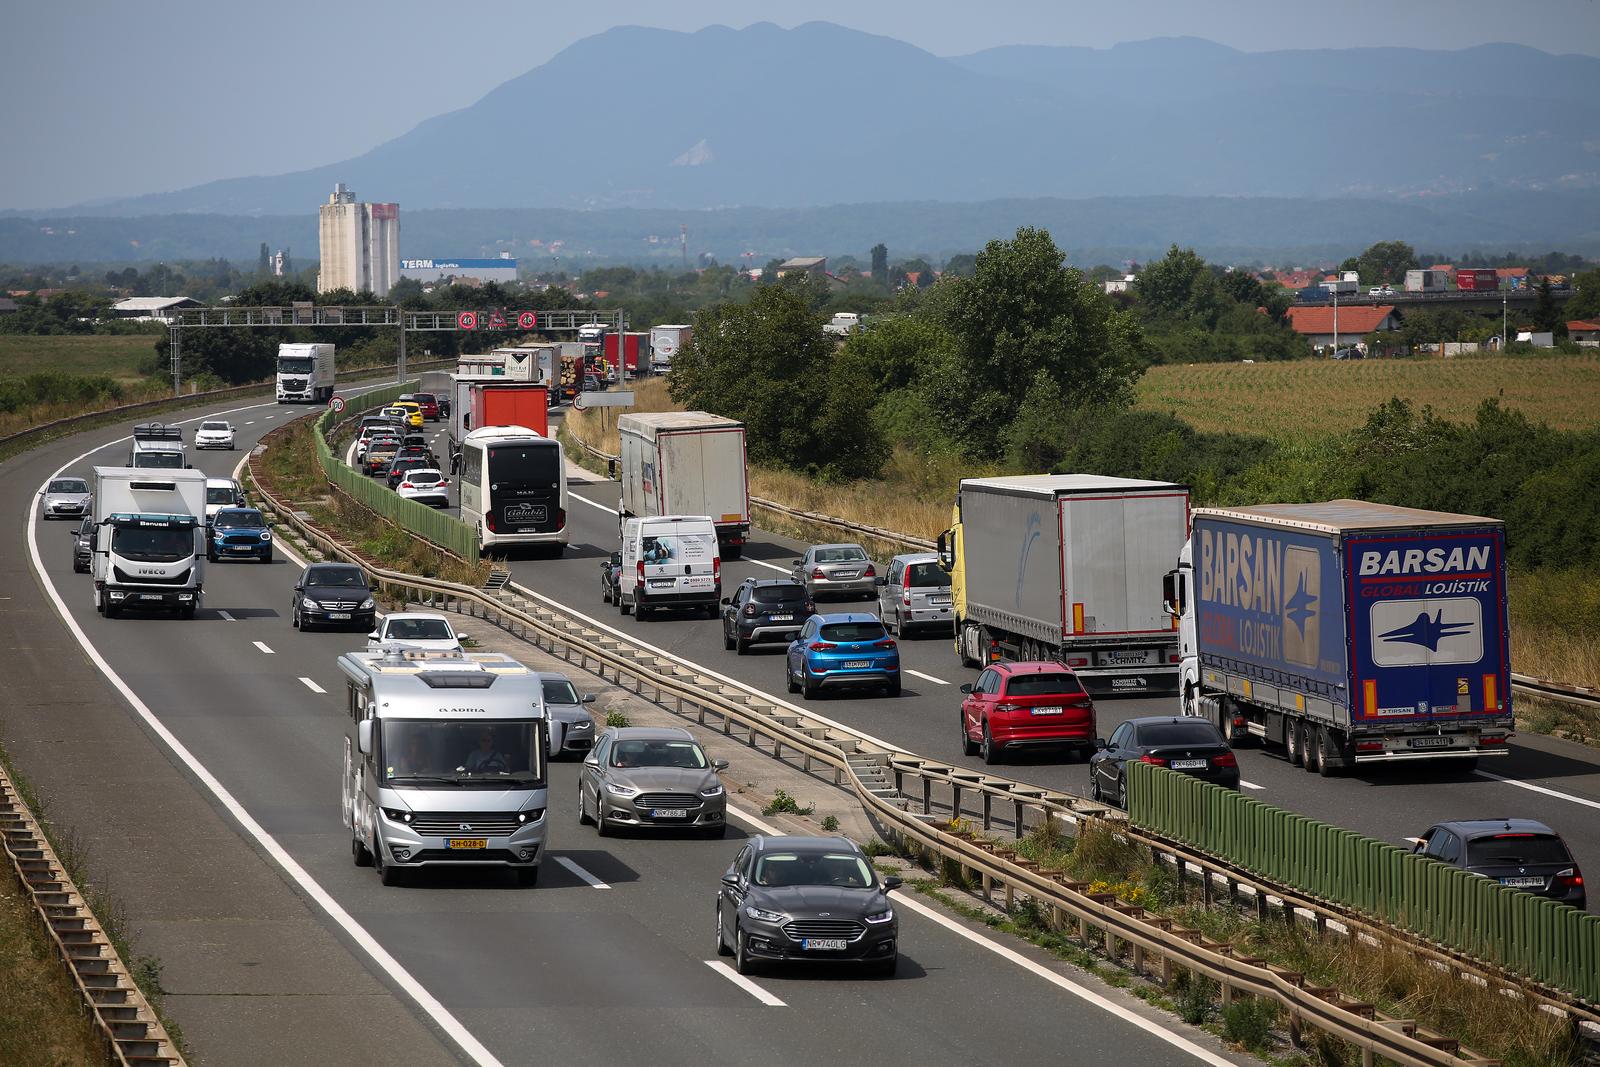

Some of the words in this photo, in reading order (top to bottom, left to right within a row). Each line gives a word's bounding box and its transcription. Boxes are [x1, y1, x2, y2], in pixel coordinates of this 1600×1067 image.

[402, 259, 433, 269] TERM
[462, 316, 473, 325] 40
[522, 316, 533, 325] 40
[1359, 545, 1491, 576] BARSAN
[1202, 528, 1281, 616] BARSAN
[1361, 584, 1421, 598] GLOBAL
[1110, 657, 1147, 665] SCHMITZ
[807, 939, 817, 949] NR
[820, 939, 847, 949] 740LG
